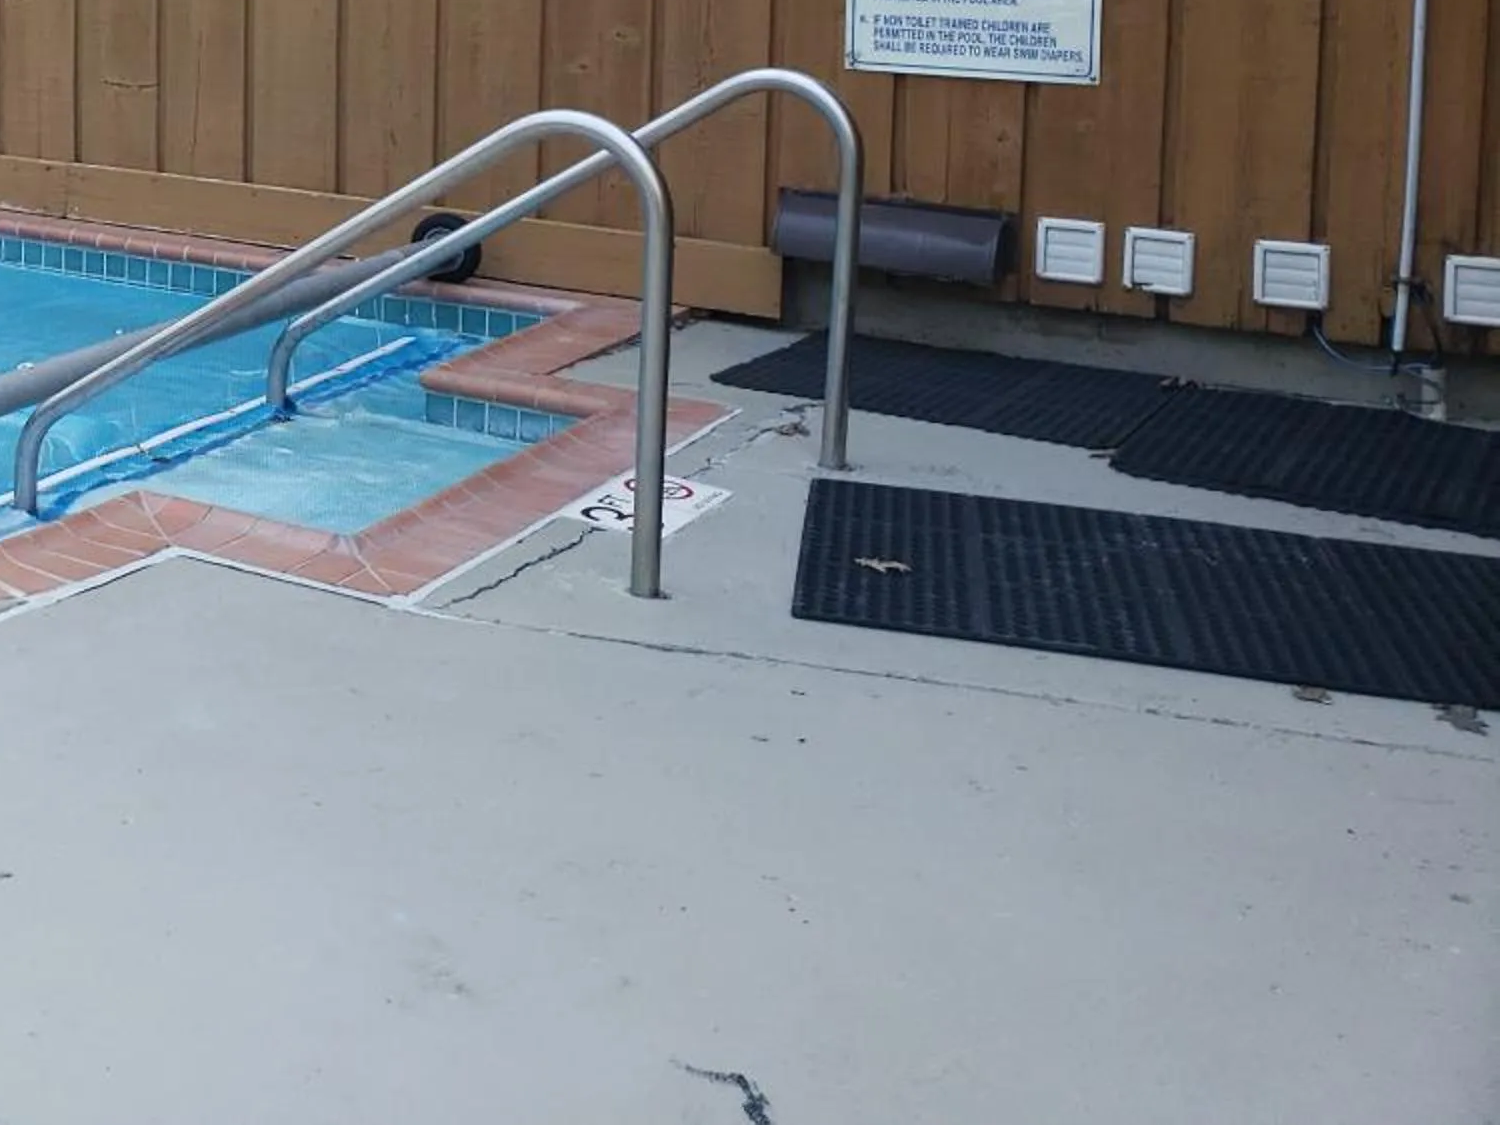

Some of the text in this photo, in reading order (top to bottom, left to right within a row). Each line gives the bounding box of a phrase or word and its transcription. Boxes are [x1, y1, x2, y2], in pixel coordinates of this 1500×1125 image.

[938, 30, 955, 42] THE
[989, 33, 1006, 45] THE
[968, 45, 980, 57] TO
